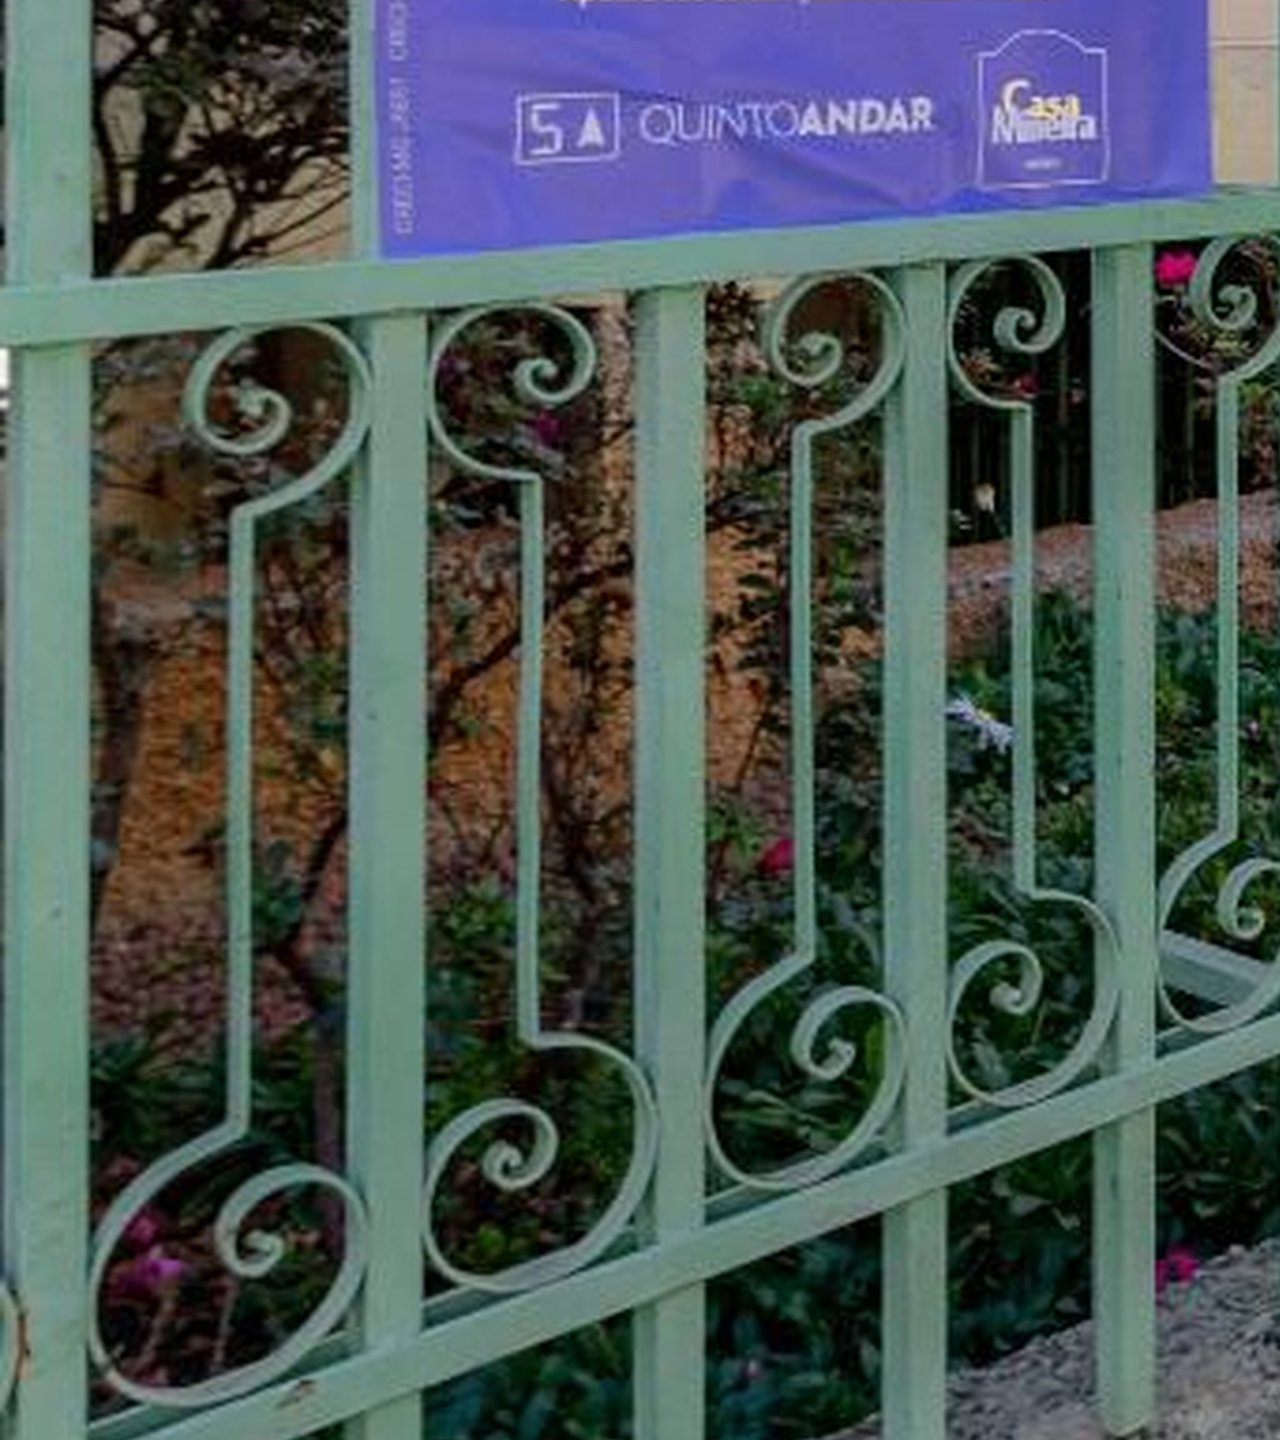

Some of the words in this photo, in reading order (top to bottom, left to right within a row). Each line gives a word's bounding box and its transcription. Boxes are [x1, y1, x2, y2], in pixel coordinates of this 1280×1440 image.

[638, 96, 934, 144] QUINTOANDAR
[1003, 79, 1081, 120] Casa
[992, 105, 1097, 145] Mineira
